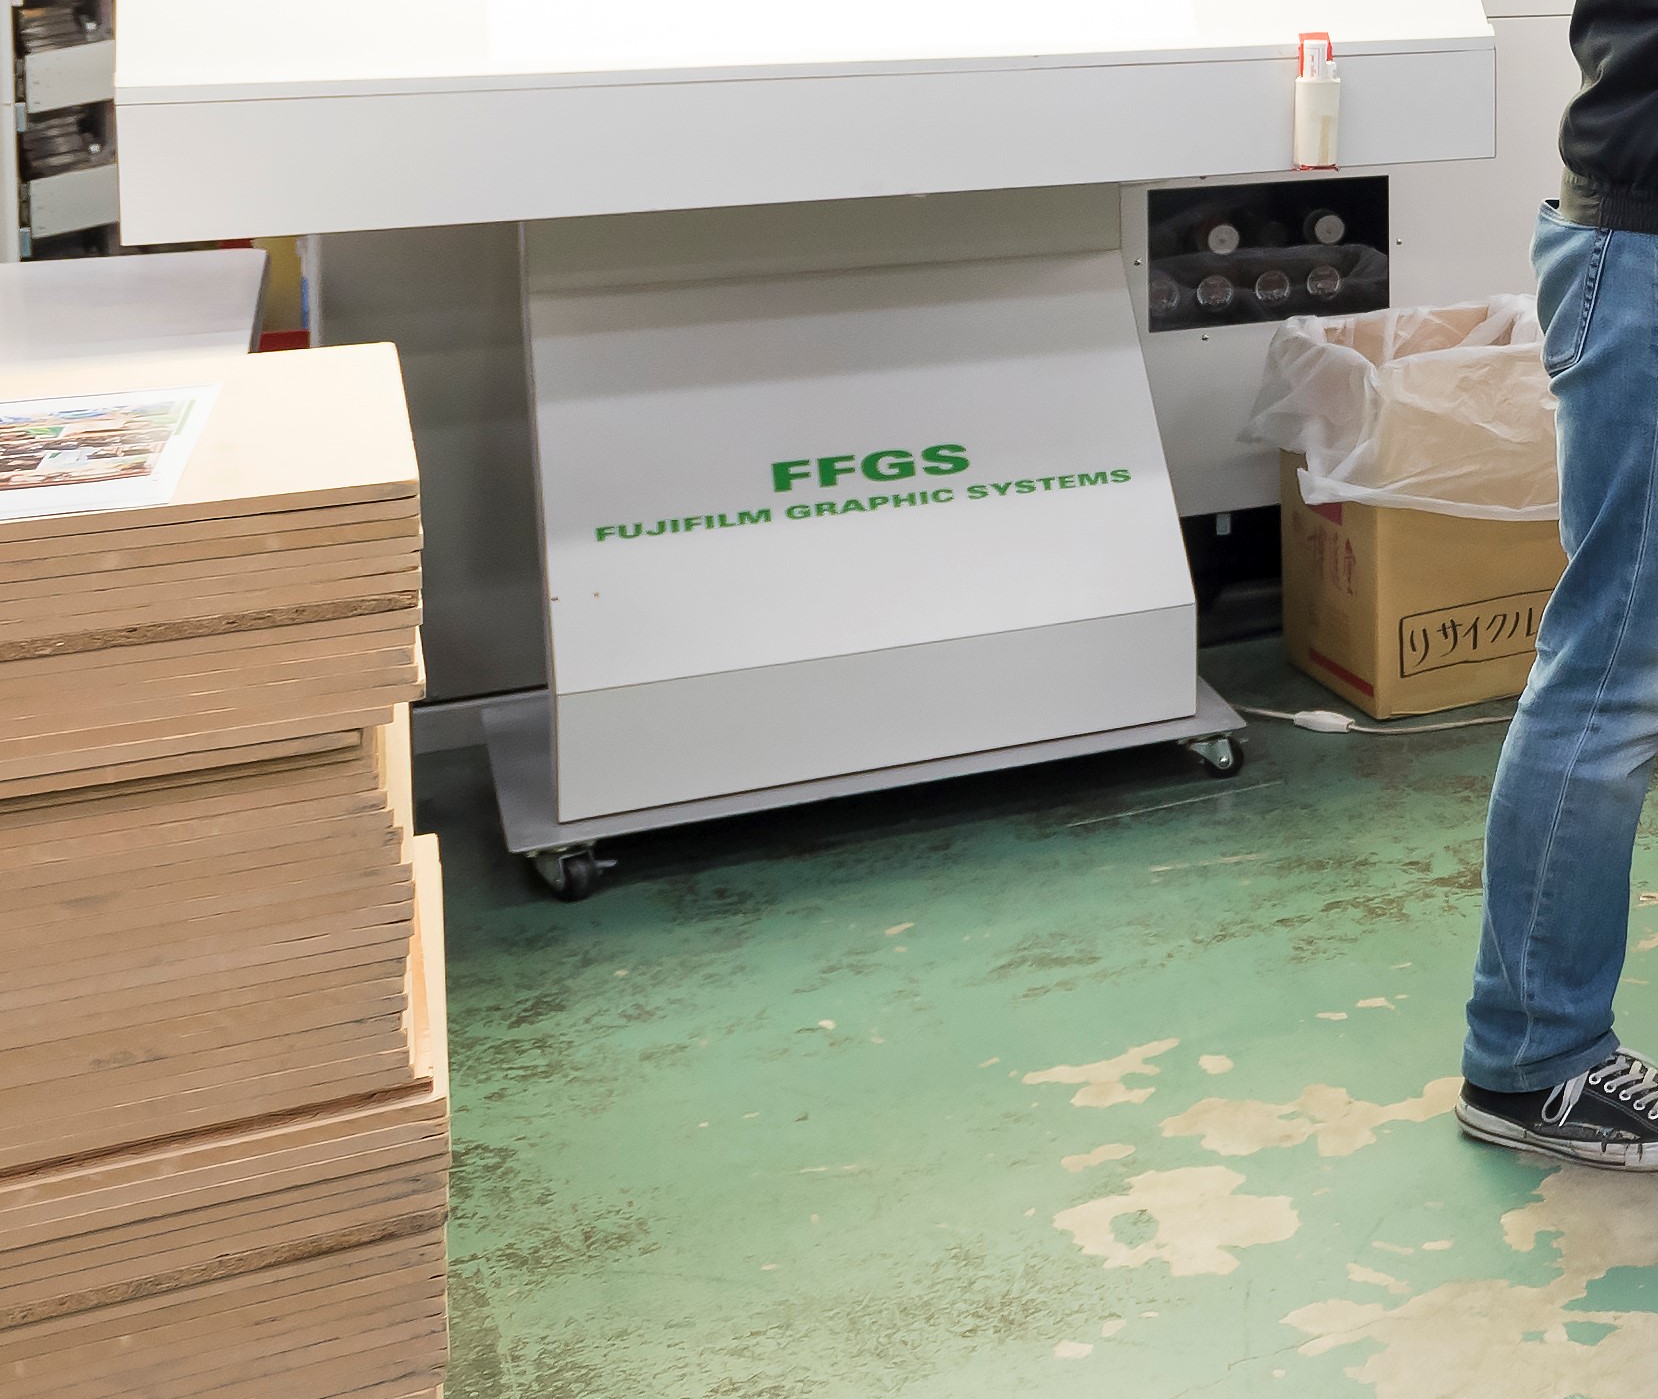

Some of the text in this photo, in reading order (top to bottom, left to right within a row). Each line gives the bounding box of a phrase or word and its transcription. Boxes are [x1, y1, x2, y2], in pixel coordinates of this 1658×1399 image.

[771, 443, 969, 493] FFGS
[595, 469, 1132, 541] FUJIFILM GRAPHIC SYSTEMS
[1409, 607, 1538, 667] リサイクル
